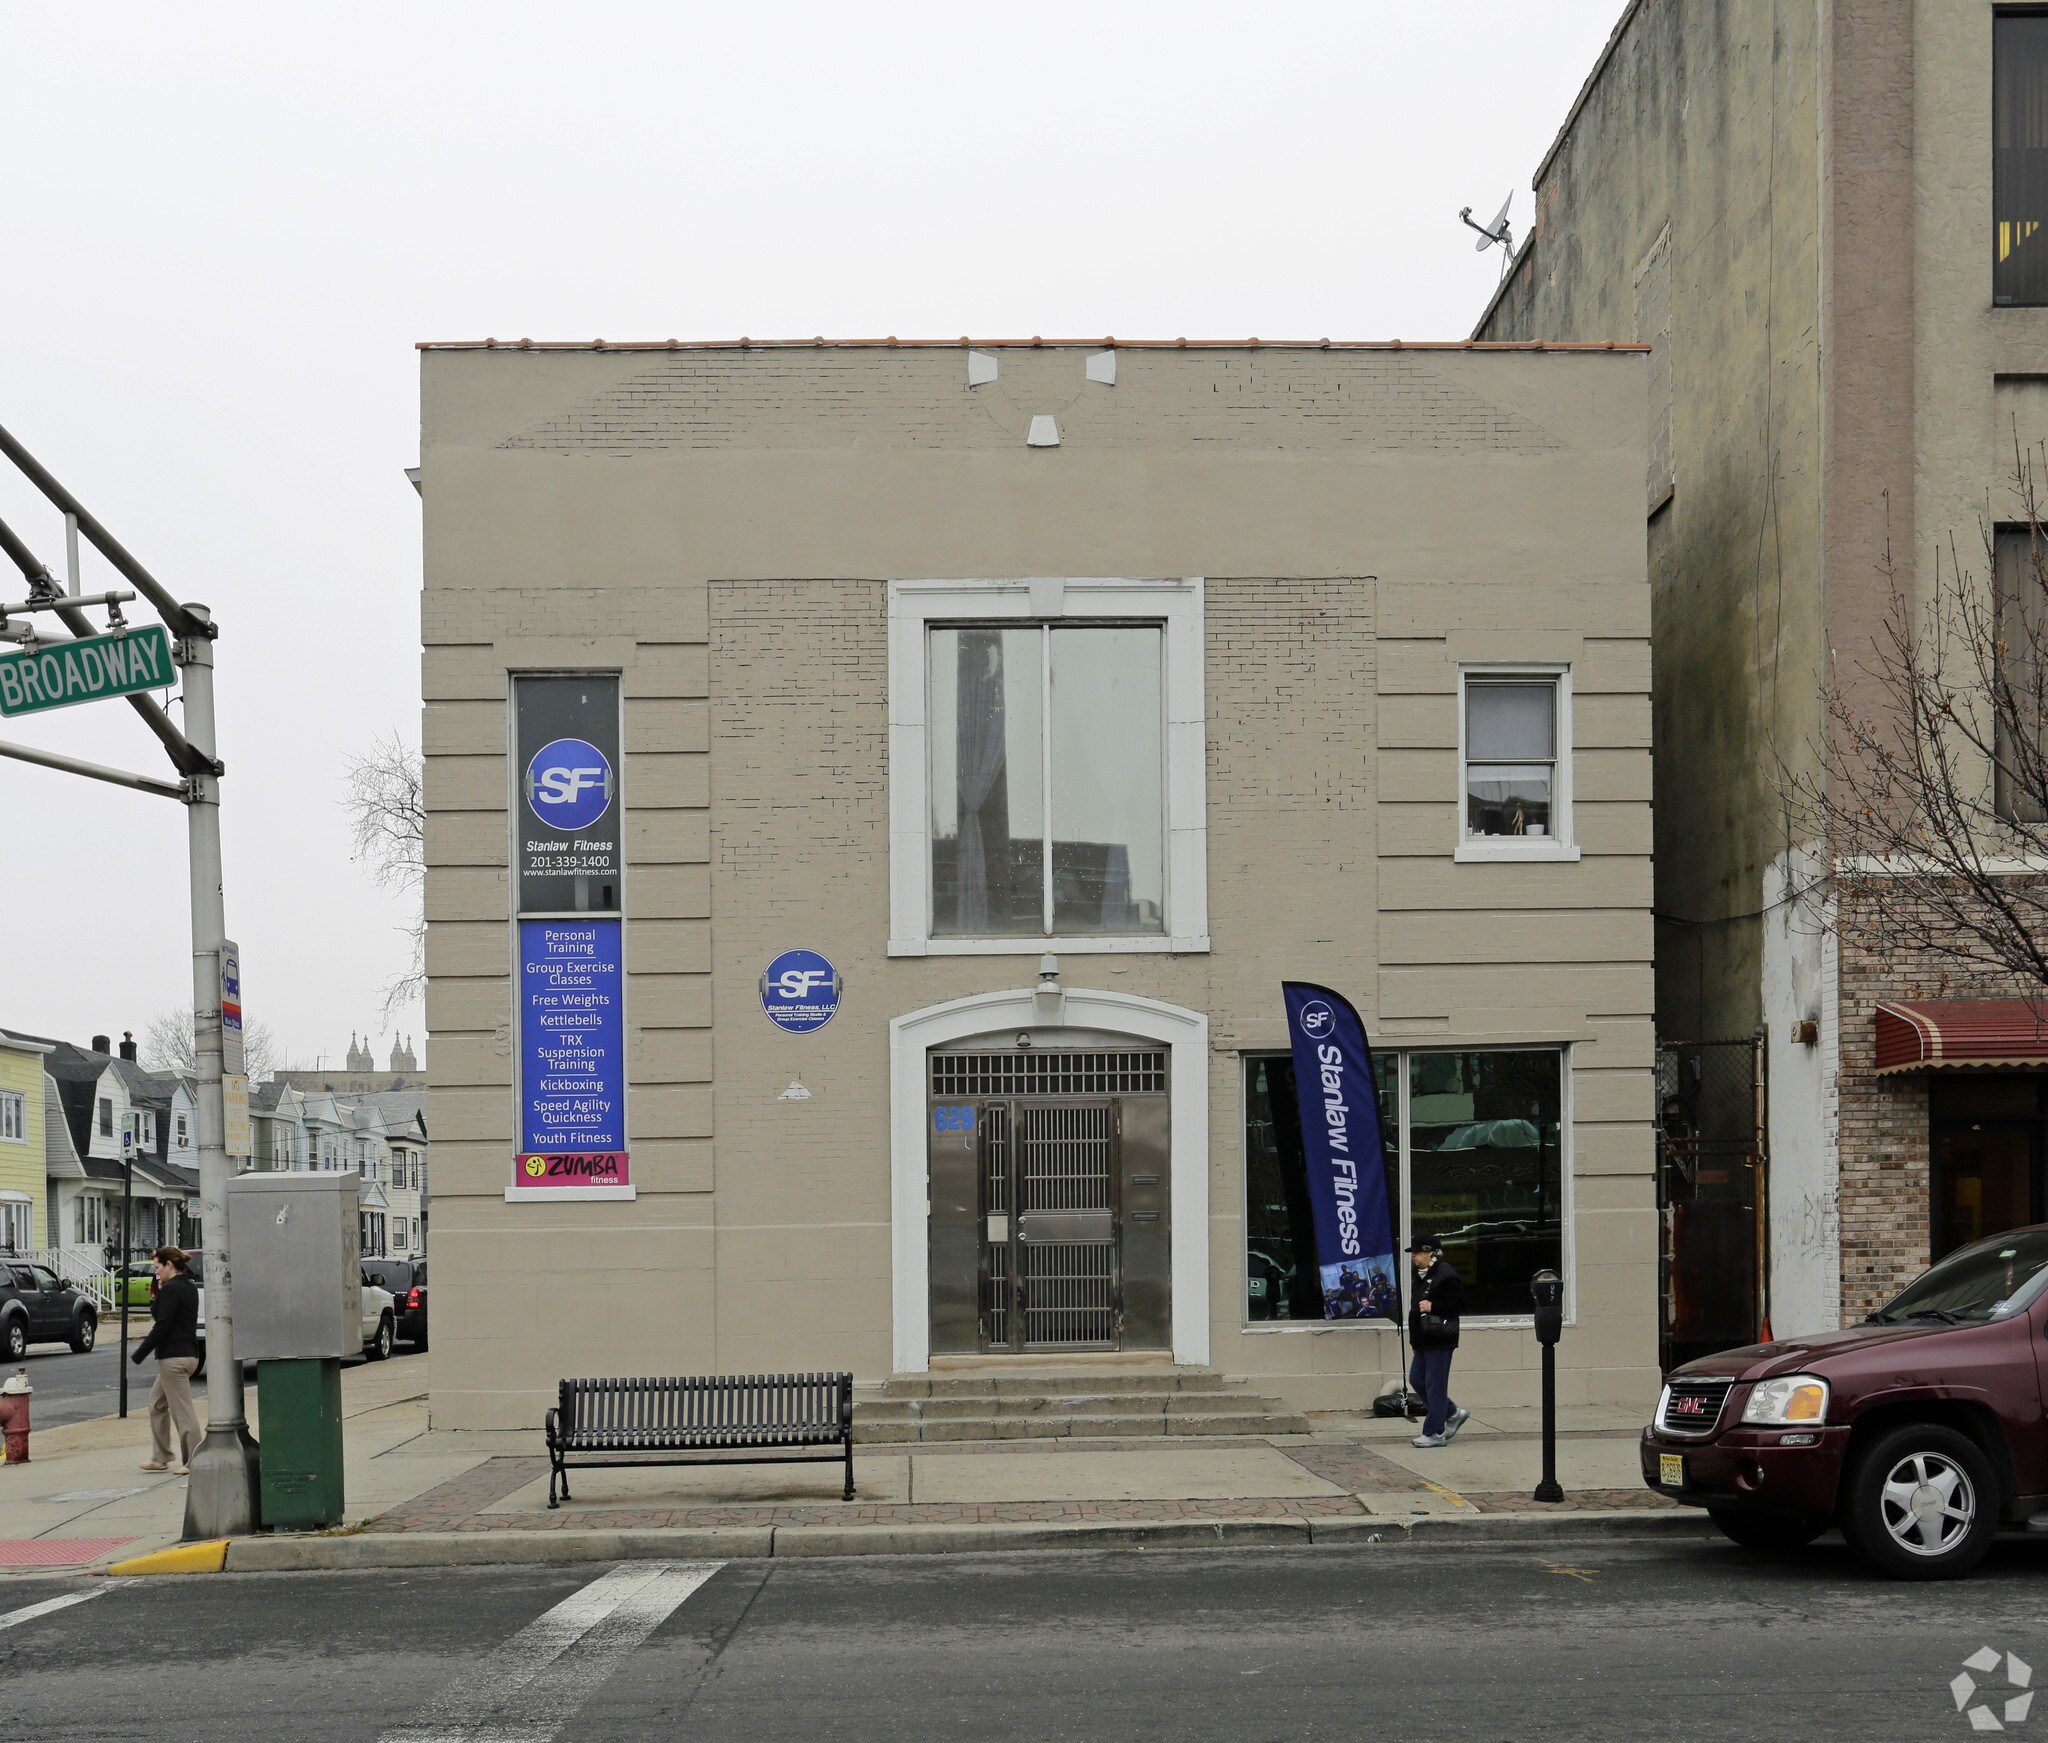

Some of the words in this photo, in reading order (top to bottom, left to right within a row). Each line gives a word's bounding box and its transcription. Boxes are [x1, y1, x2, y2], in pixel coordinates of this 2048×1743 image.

[0, 634, 161, 708] BROADWAY
[538, 767, 601, 804] SF
[526, 840, 569, 852] Stanlaw
[573, 839, 613, 851] Fitness
[530, 855, 610, 868] 201-339-1400
[523, 867, 618, 877] www.stanlawfitness.com
[545, 929, 596, 941] Personal
[546, 941, 594, 955] Training
[526, 962, 564, 975] Group
[567, 961, 615, 973] Exercise
[549, 974, 592, 985] Classes
[778, 970, 826, 998] SF
[532, 994, 558, 1006] Free
[561, 993, 610, 1007] Weights
[540, 1013, 602, 1026] Kettlebells
[1306, 1011, 1329, 1029] SF
[559, 1034, 583, 1046] TRX
[537, 1046, 605, 1060] Suspension
[548, 1058, 595, 1072] Training
[540, 1079, 604, 1092] Kickboxing
[1317, 1043, 1350, 1153] Stanlaw
[533, 1099, 570, 1113] Speed
[573, 1099, 611, 1112] Agility
[542, 1112, 602, 1123] Quickness
[934, 1105, 975, 1131] 629
[532, 1132, 567, 1144] Youth
[570, 1132, 612, 1143] Fitness
[547, 1154, 618, 1177] ZUMBA
[590, 1176, 619, 1184] fitness
[1331, 1158, 1361, 1256] Fitness
[1676, 1397, 1707, 1414] GMC
